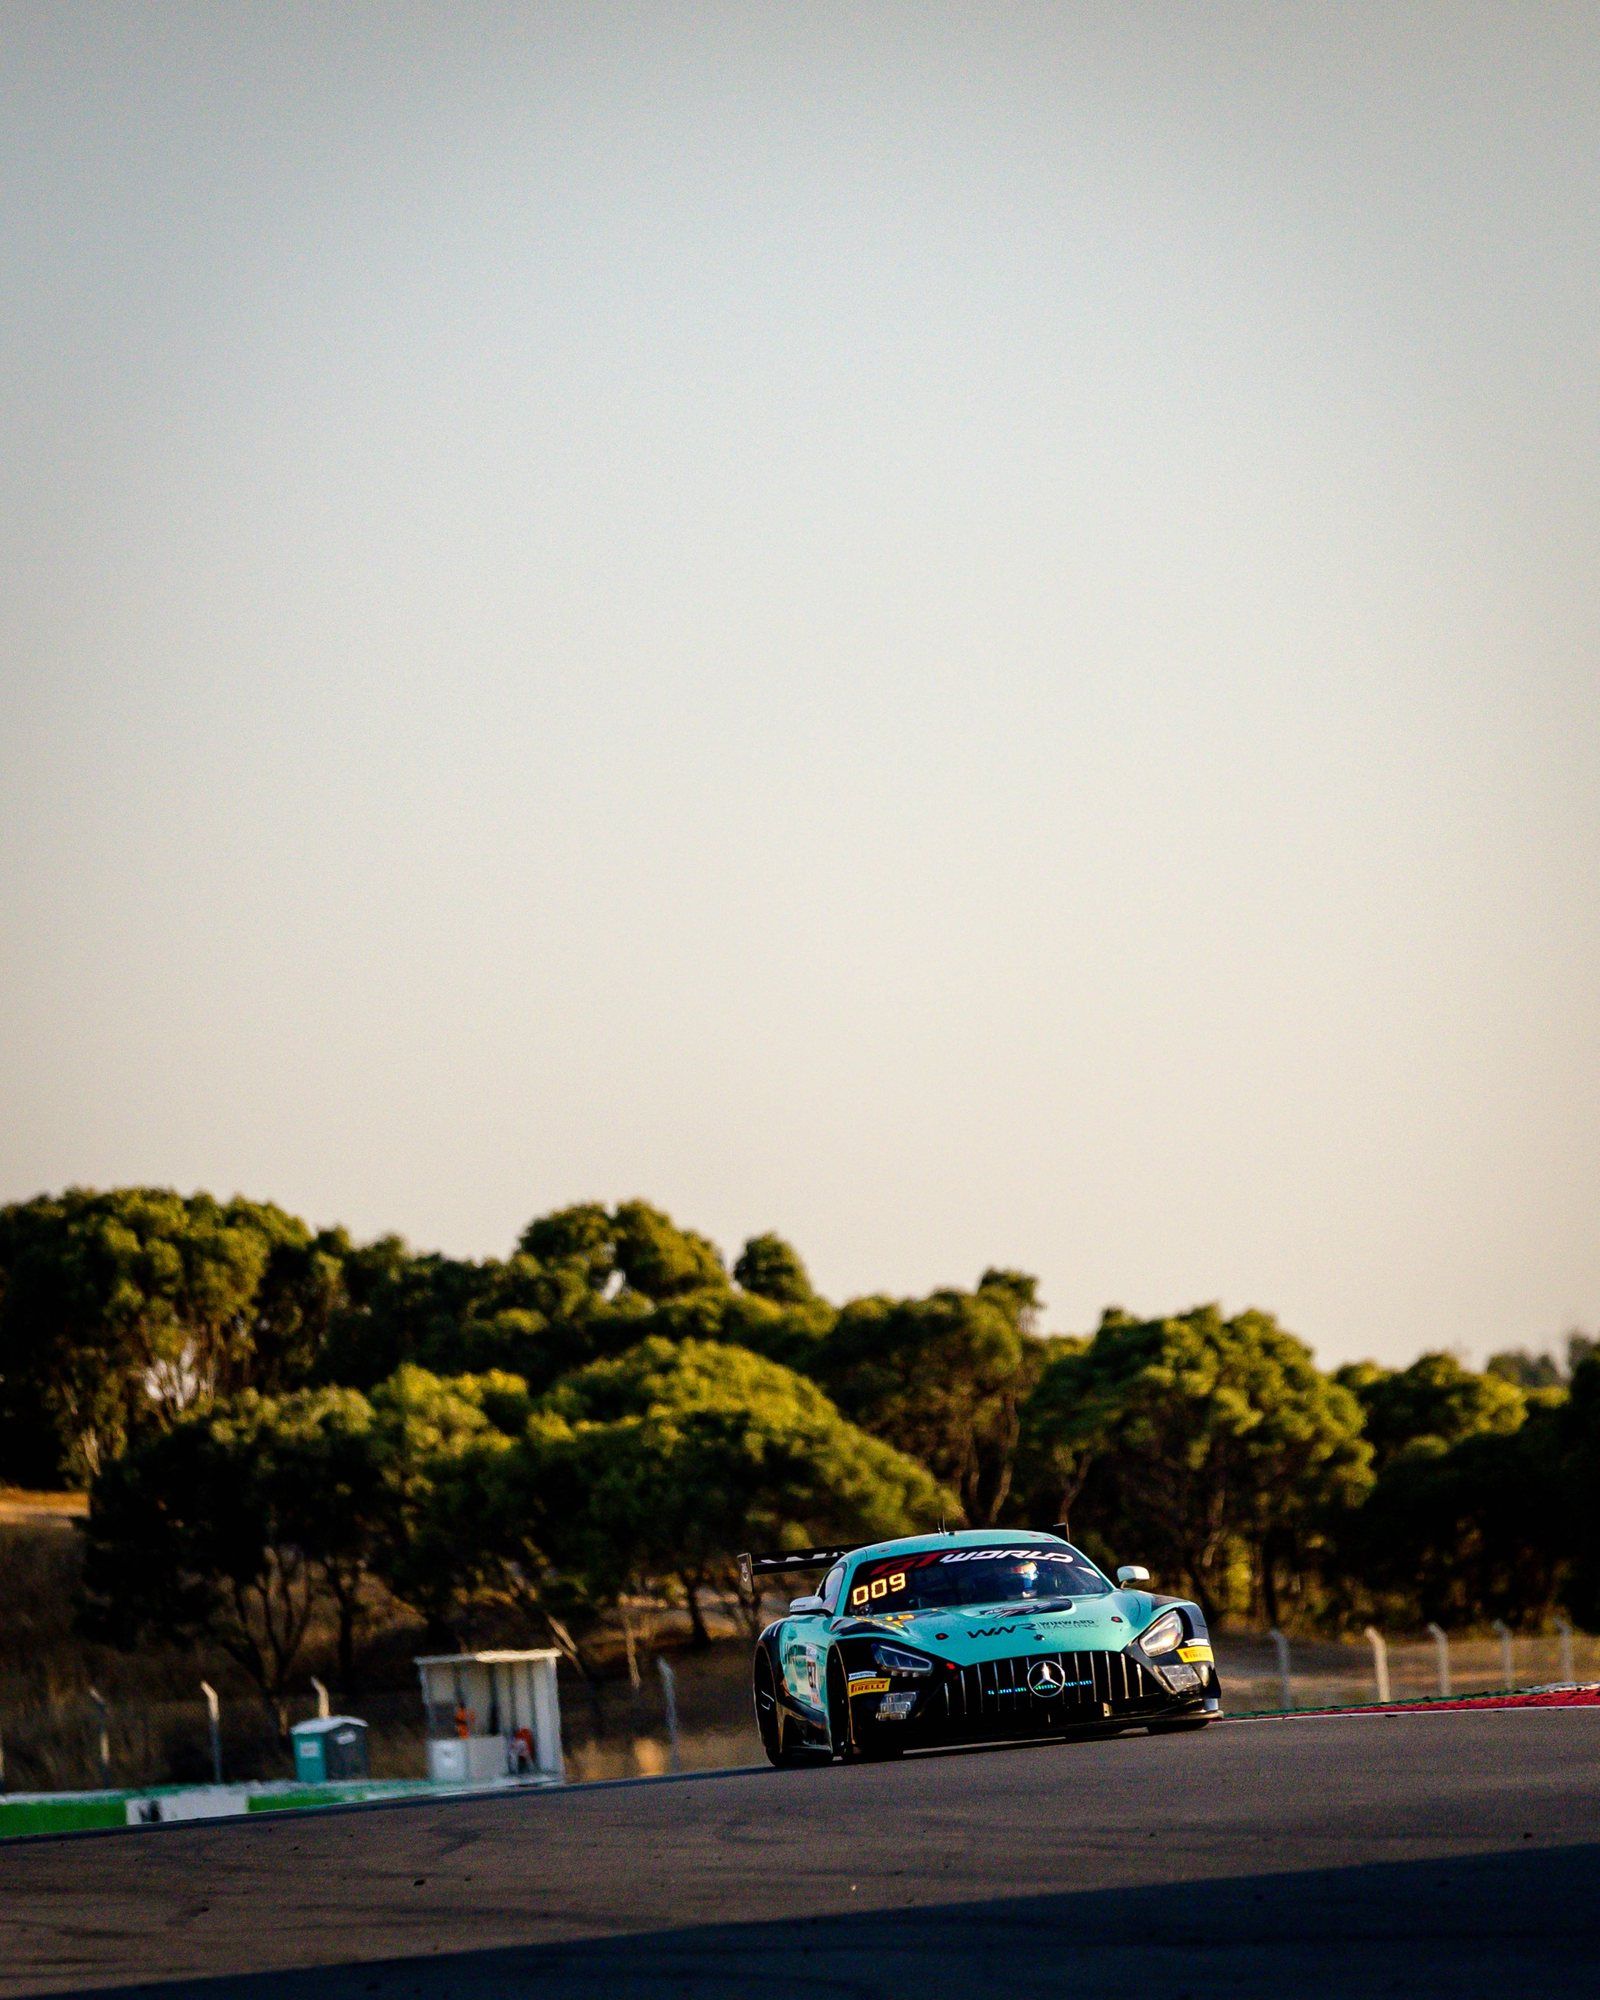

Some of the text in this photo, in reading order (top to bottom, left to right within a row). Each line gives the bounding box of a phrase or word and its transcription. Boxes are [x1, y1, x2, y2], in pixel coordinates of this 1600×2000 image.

[939, 1549, 1075, 1564] WORLD
[852, 1571, 907, 1606] 009
[850, 1679, 889, 1694] PIRELLI
